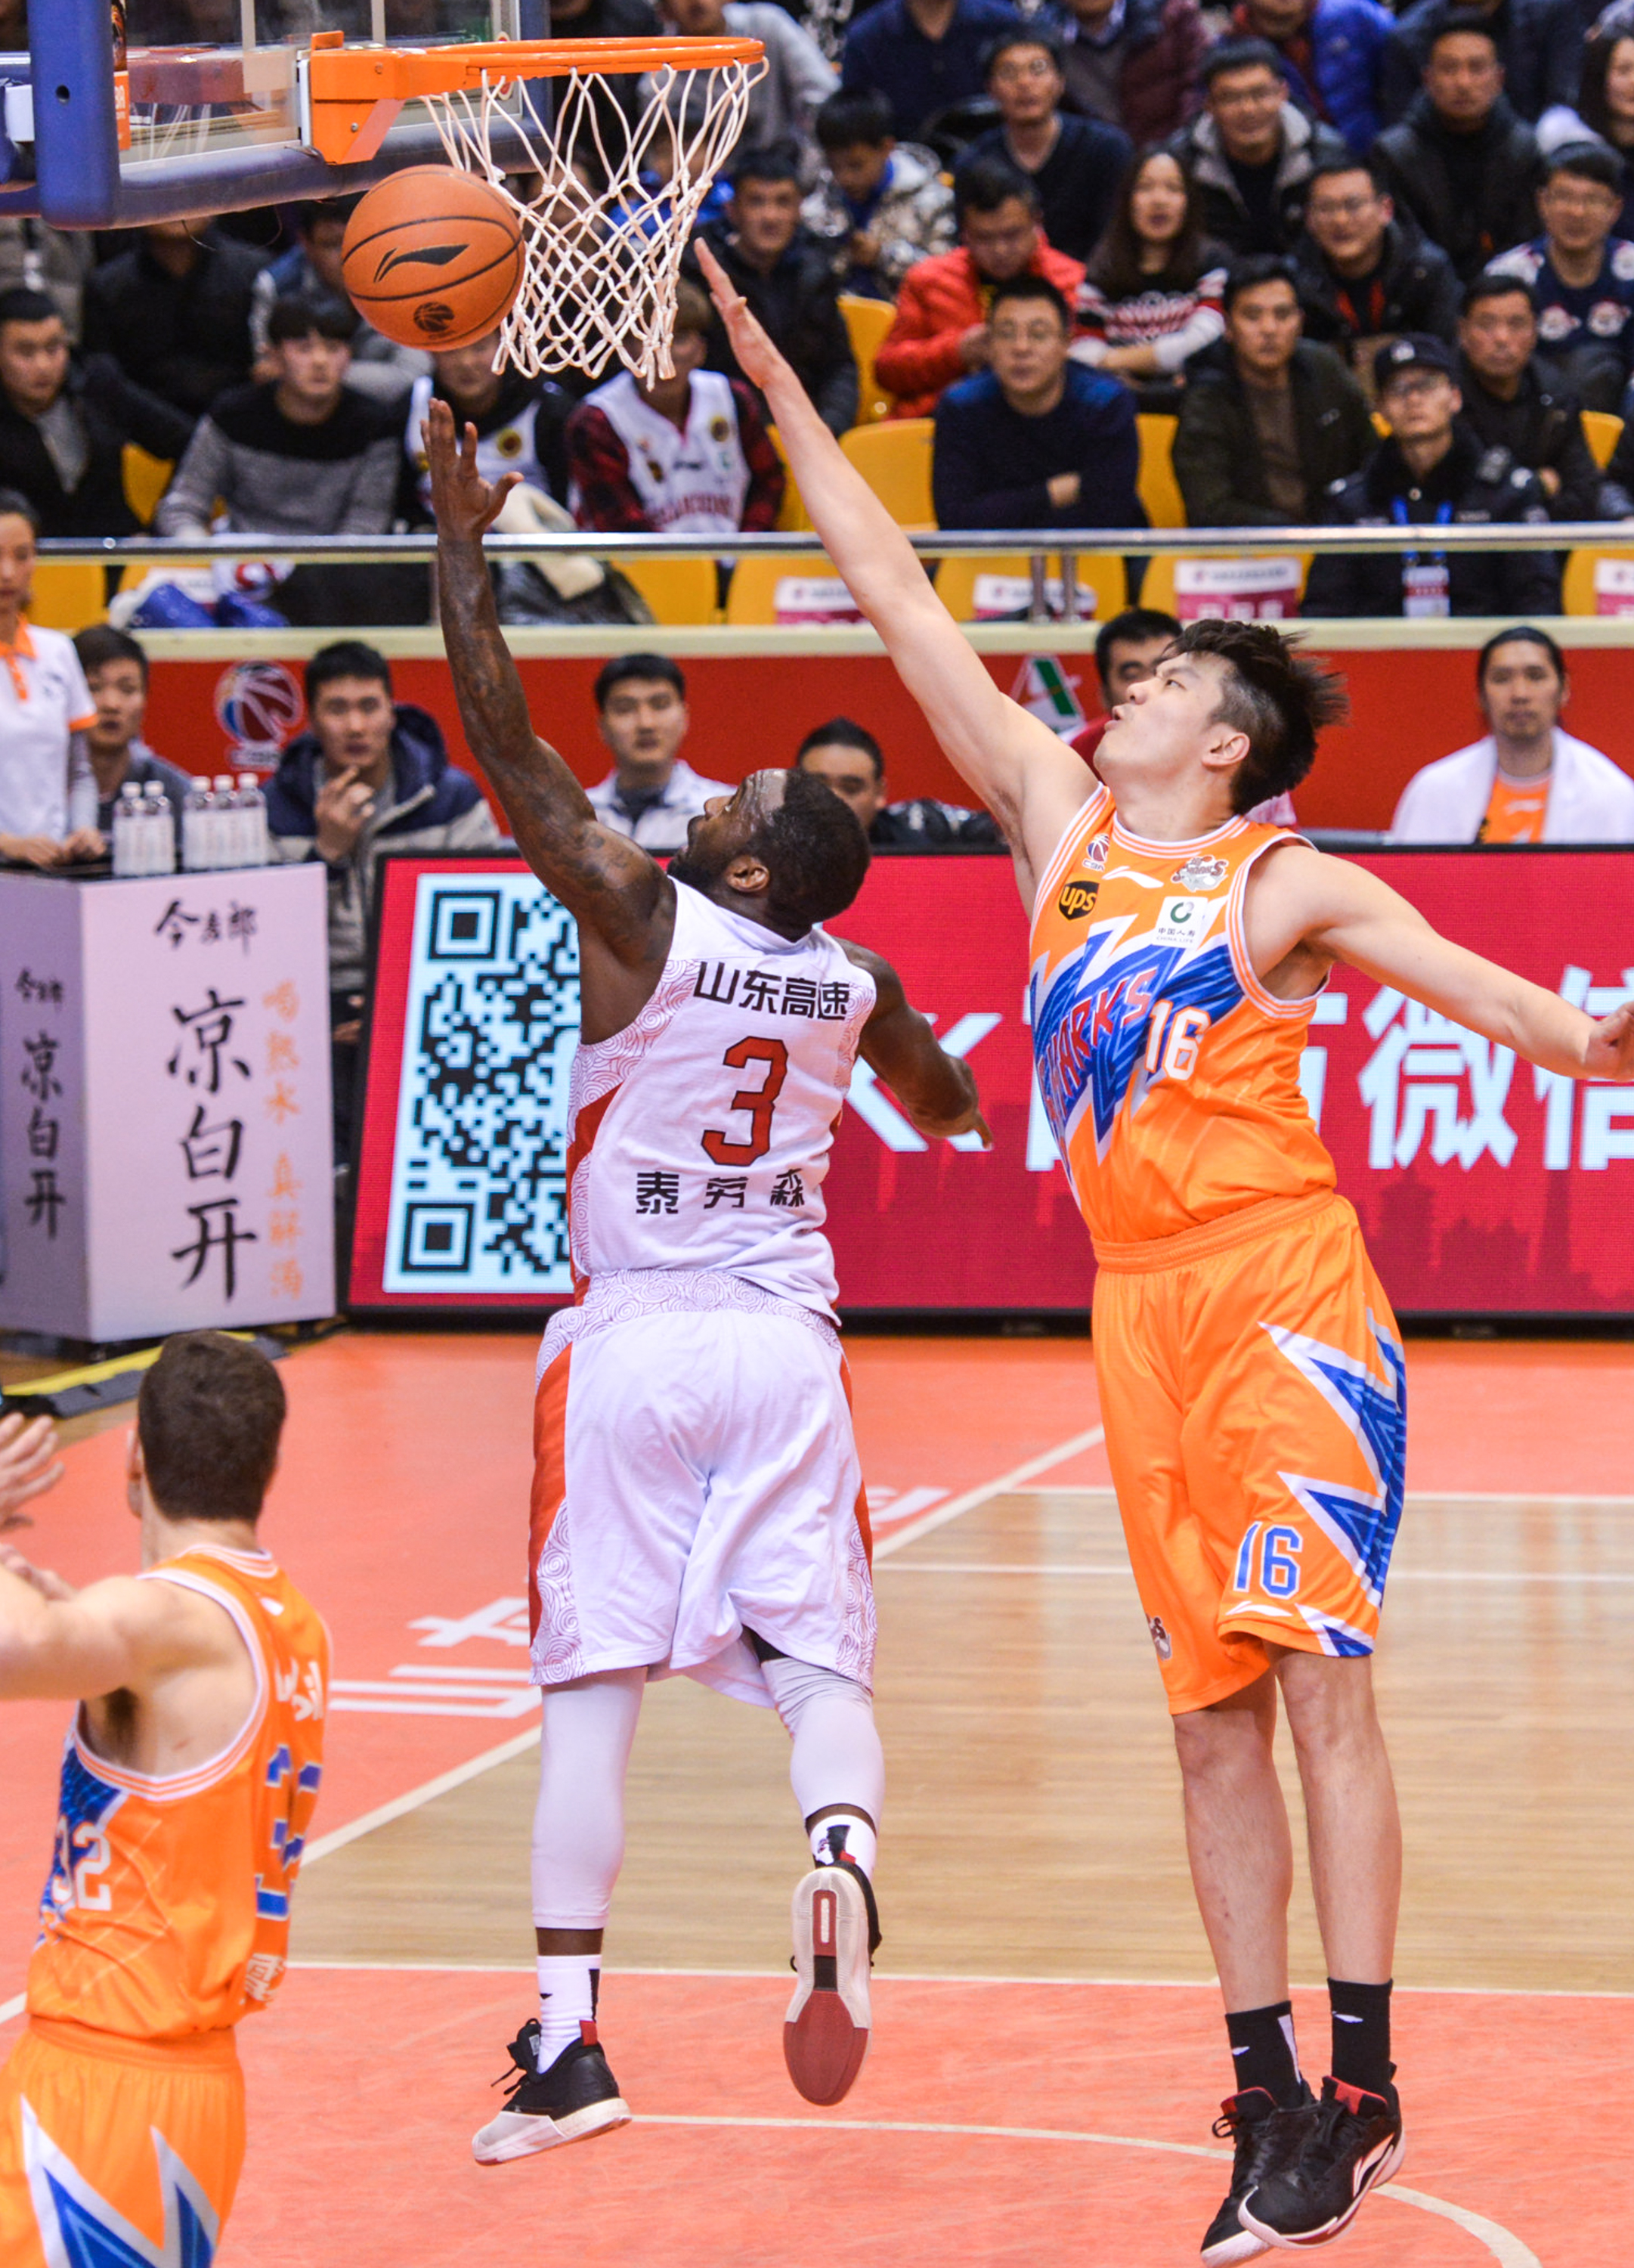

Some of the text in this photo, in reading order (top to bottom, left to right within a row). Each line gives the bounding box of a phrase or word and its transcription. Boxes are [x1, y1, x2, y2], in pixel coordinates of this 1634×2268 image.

[693, 961, 849, 1020] 山东高速
[1145, 999, 1211, 1080] 16
[701, 1036, 788, 1167] 3
[168, 990, 258, 1303] 凉白开
[636, 1168, 804, 1214] 泰劳森
[1233, 1520, 1303, 1600] 16
